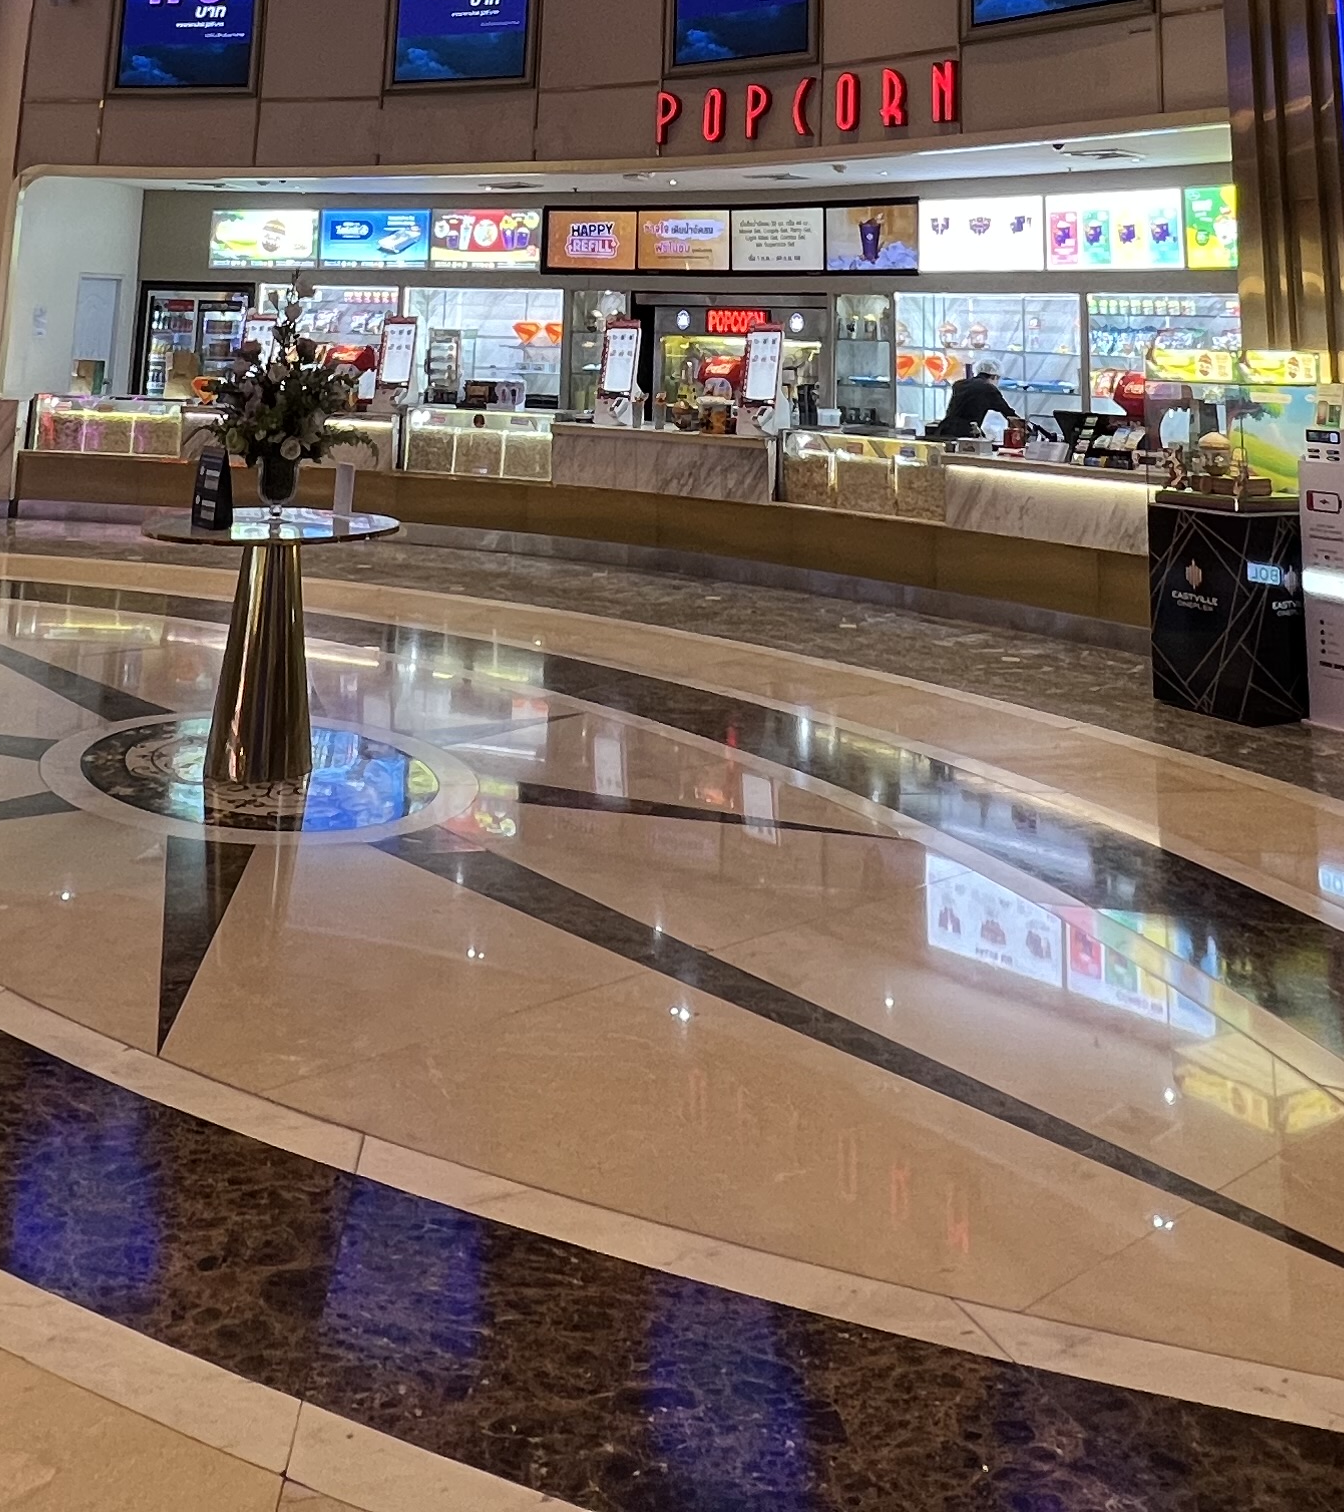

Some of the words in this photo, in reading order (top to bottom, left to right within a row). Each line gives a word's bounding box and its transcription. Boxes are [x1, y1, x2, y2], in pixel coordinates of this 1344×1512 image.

[195, 6, 227, 19] บาท
[656, 59, 956, 145] POPCORN
[572, 223, 613, 237] HAPPY
[572, 239, 612, 252] REFILL
[1171, 590, 1219, 607] EASTVILLE
